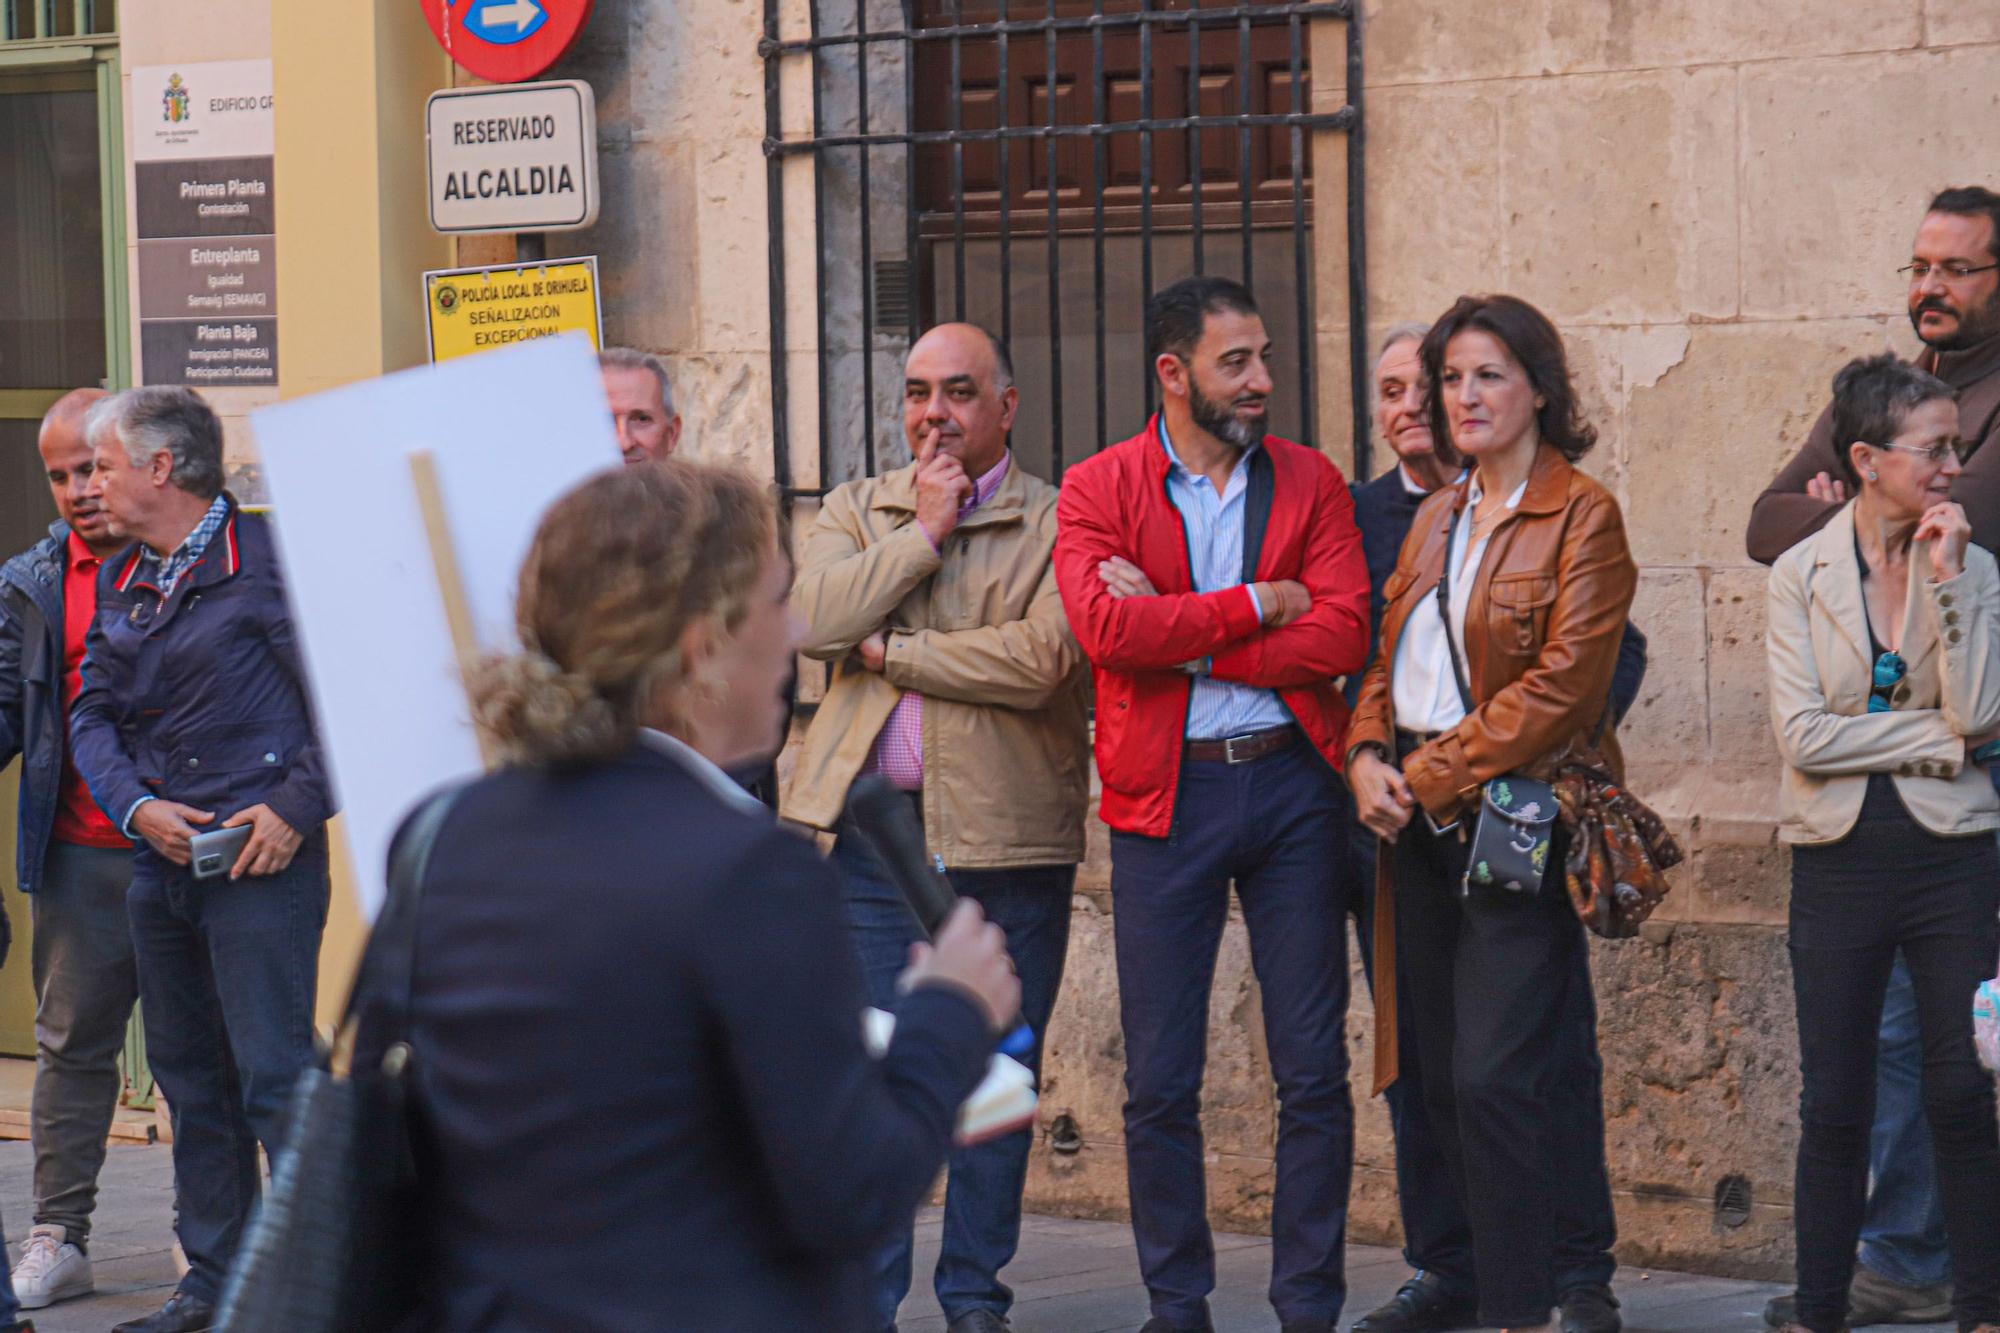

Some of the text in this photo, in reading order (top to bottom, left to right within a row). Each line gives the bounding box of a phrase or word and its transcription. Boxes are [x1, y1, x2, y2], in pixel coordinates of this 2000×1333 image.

[209, 96, 257, 112] EDIFICIO
[453, 114, 555, 145] RESERVADO
[180, 179, 266, 198] Primera Planta
[444, 164, 575, 201] ALCALDIA
[190, 246, 260, 267] Entreplanta
[502, 283, 530, 300] LOCAL
[534, 281, 544, 297] DE
[546, 277, 588, 296] ORIHUELA
[469, 303, 561, 325] SEÑALIZACIÓN
[197, 323, 258, 342] Planta Baja
